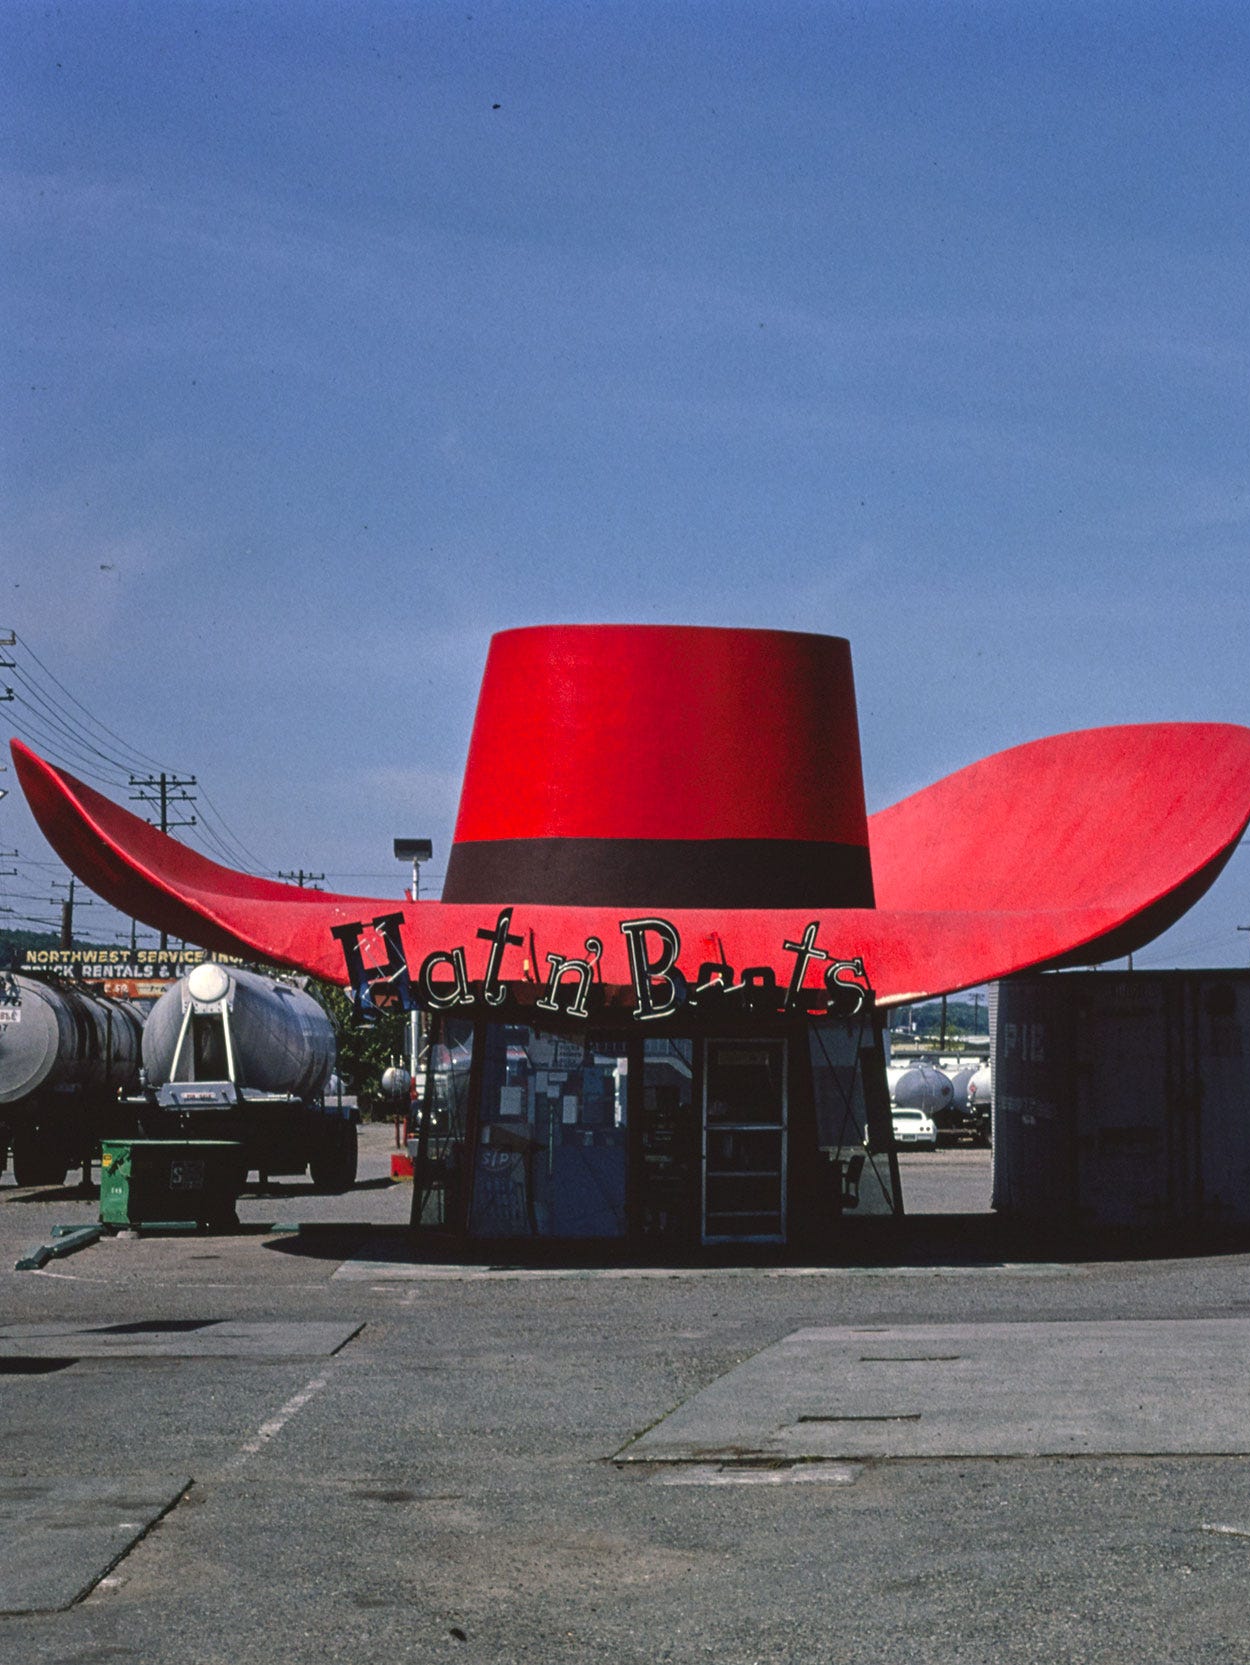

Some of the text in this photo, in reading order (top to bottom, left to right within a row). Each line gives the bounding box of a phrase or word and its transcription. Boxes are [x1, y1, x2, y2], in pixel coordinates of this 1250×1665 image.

[26, 950, 132, 963] NORTHWEST
[137, 950, 204, 963] SERVICE
[82, 965, 154, 977] RENTALS
[159, 965, 170, 977] &
[330, 907, 524, 1028] Hat
[620, 917, 866, 1021] Boots
